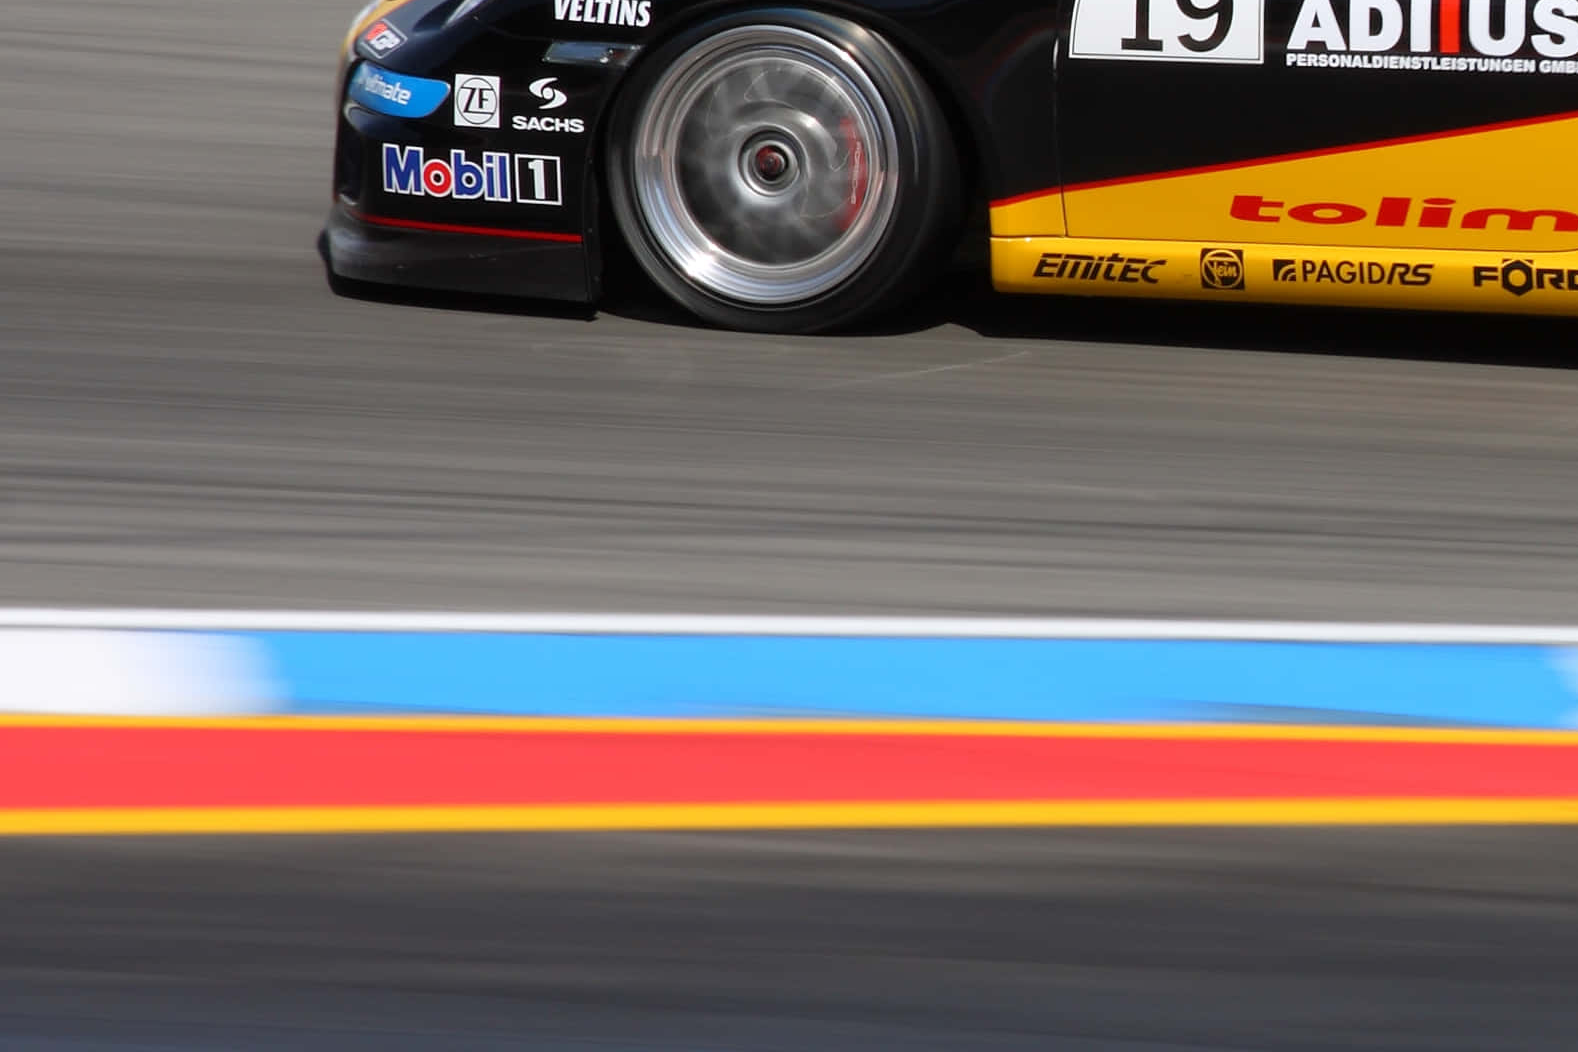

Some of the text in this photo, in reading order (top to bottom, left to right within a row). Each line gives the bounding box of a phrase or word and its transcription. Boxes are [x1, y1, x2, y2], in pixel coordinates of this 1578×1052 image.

[1286, 53, 1536, 73] PERSONALDIENSTLEISTUNGEN
[459, 86, 494, 115] ZF
[512, 115, 585, 133] SACHS
[382, 143, 511, 203] Mobil
